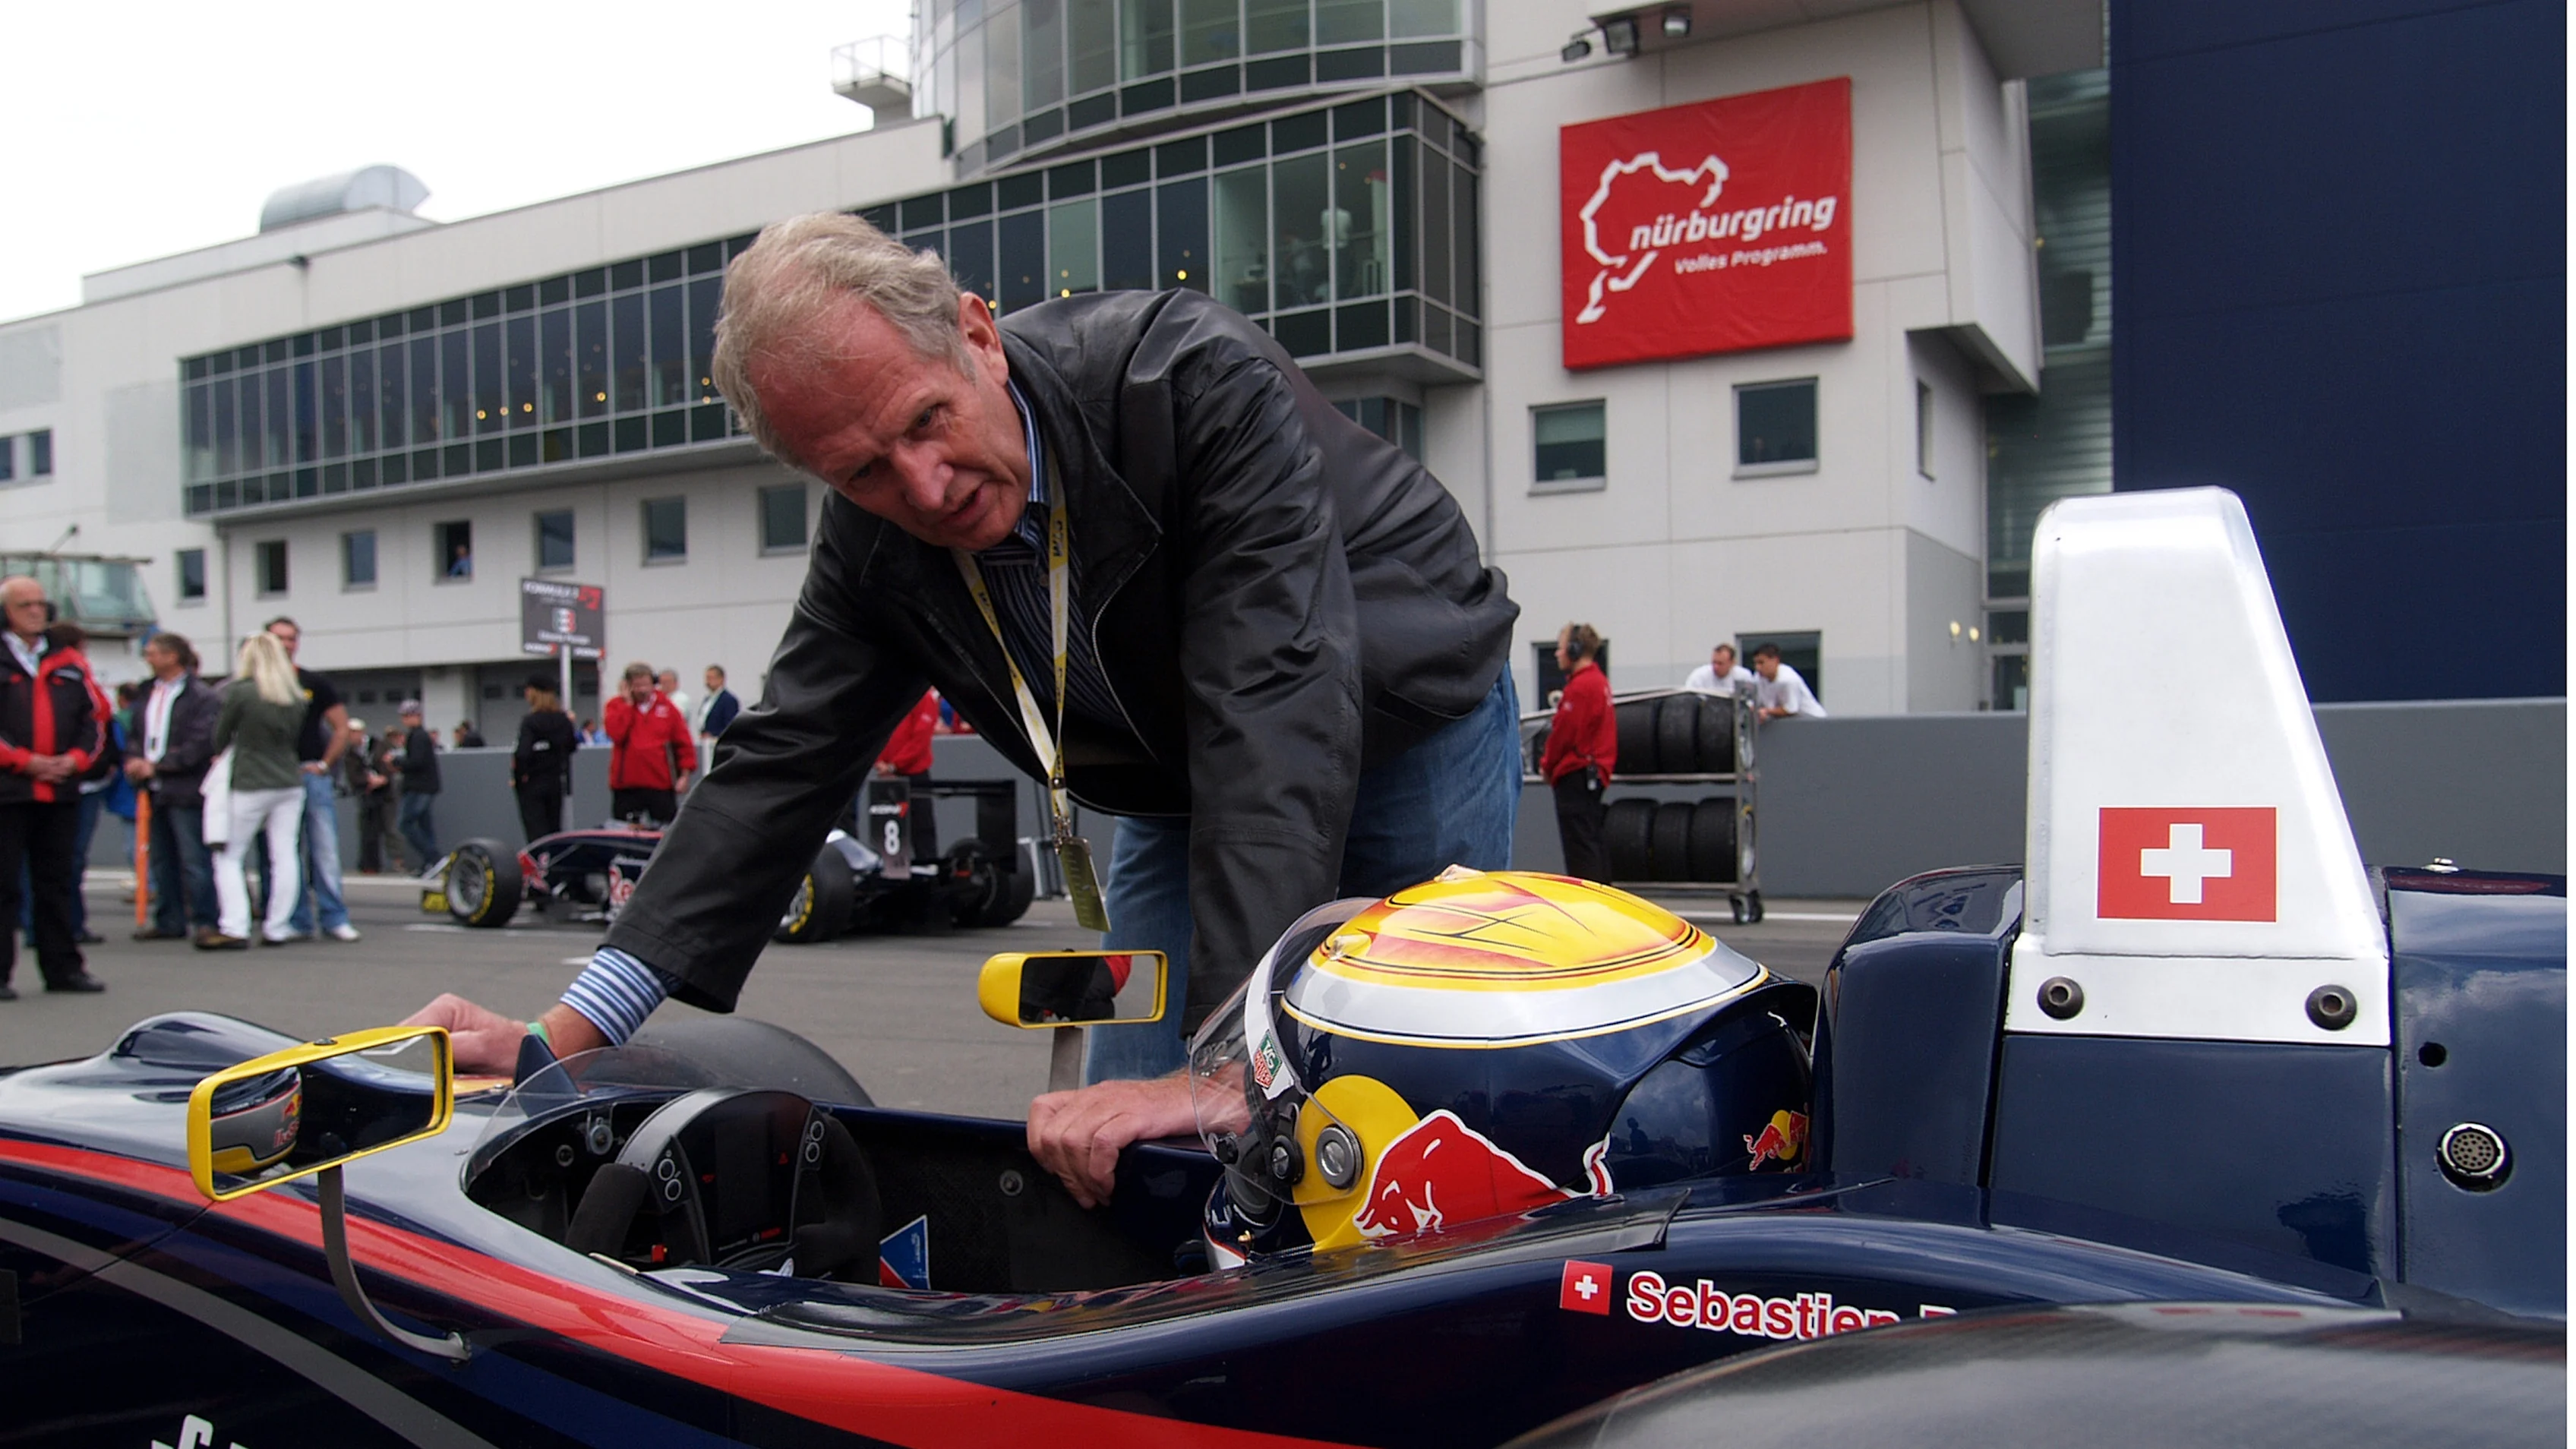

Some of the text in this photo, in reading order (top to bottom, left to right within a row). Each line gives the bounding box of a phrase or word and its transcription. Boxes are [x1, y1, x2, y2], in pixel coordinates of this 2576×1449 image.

[1629, 195, 1837, 251] nürburgring
[1675, 240, 1828, 274] Volles Programm.
[884, 819, 901, 856] 8
